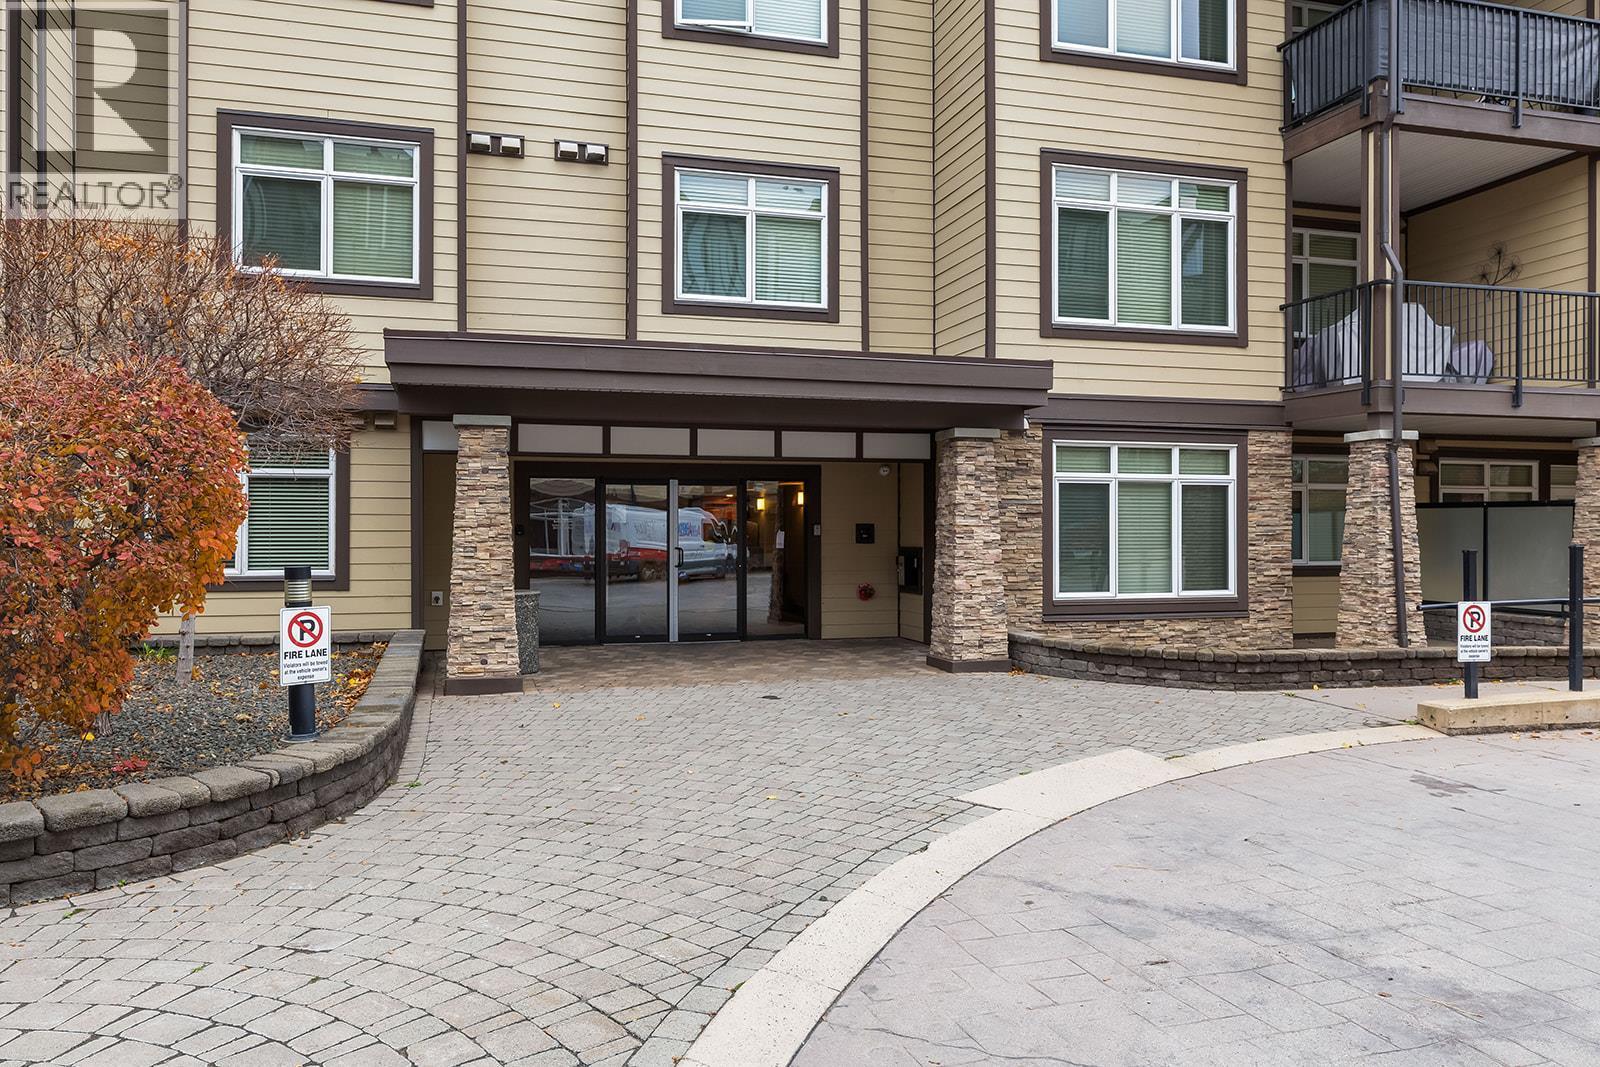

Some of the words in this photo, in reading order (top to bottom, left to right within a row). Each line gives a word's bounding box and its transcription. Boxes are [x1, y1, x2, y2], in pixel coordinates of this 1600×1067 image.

[1460, 634, 1473, 642] FIRE
[1474, 634, 1489, 642] LANE
[284, 650, 303, 660] FIRE
[305, 648, 328, 658] LANE
